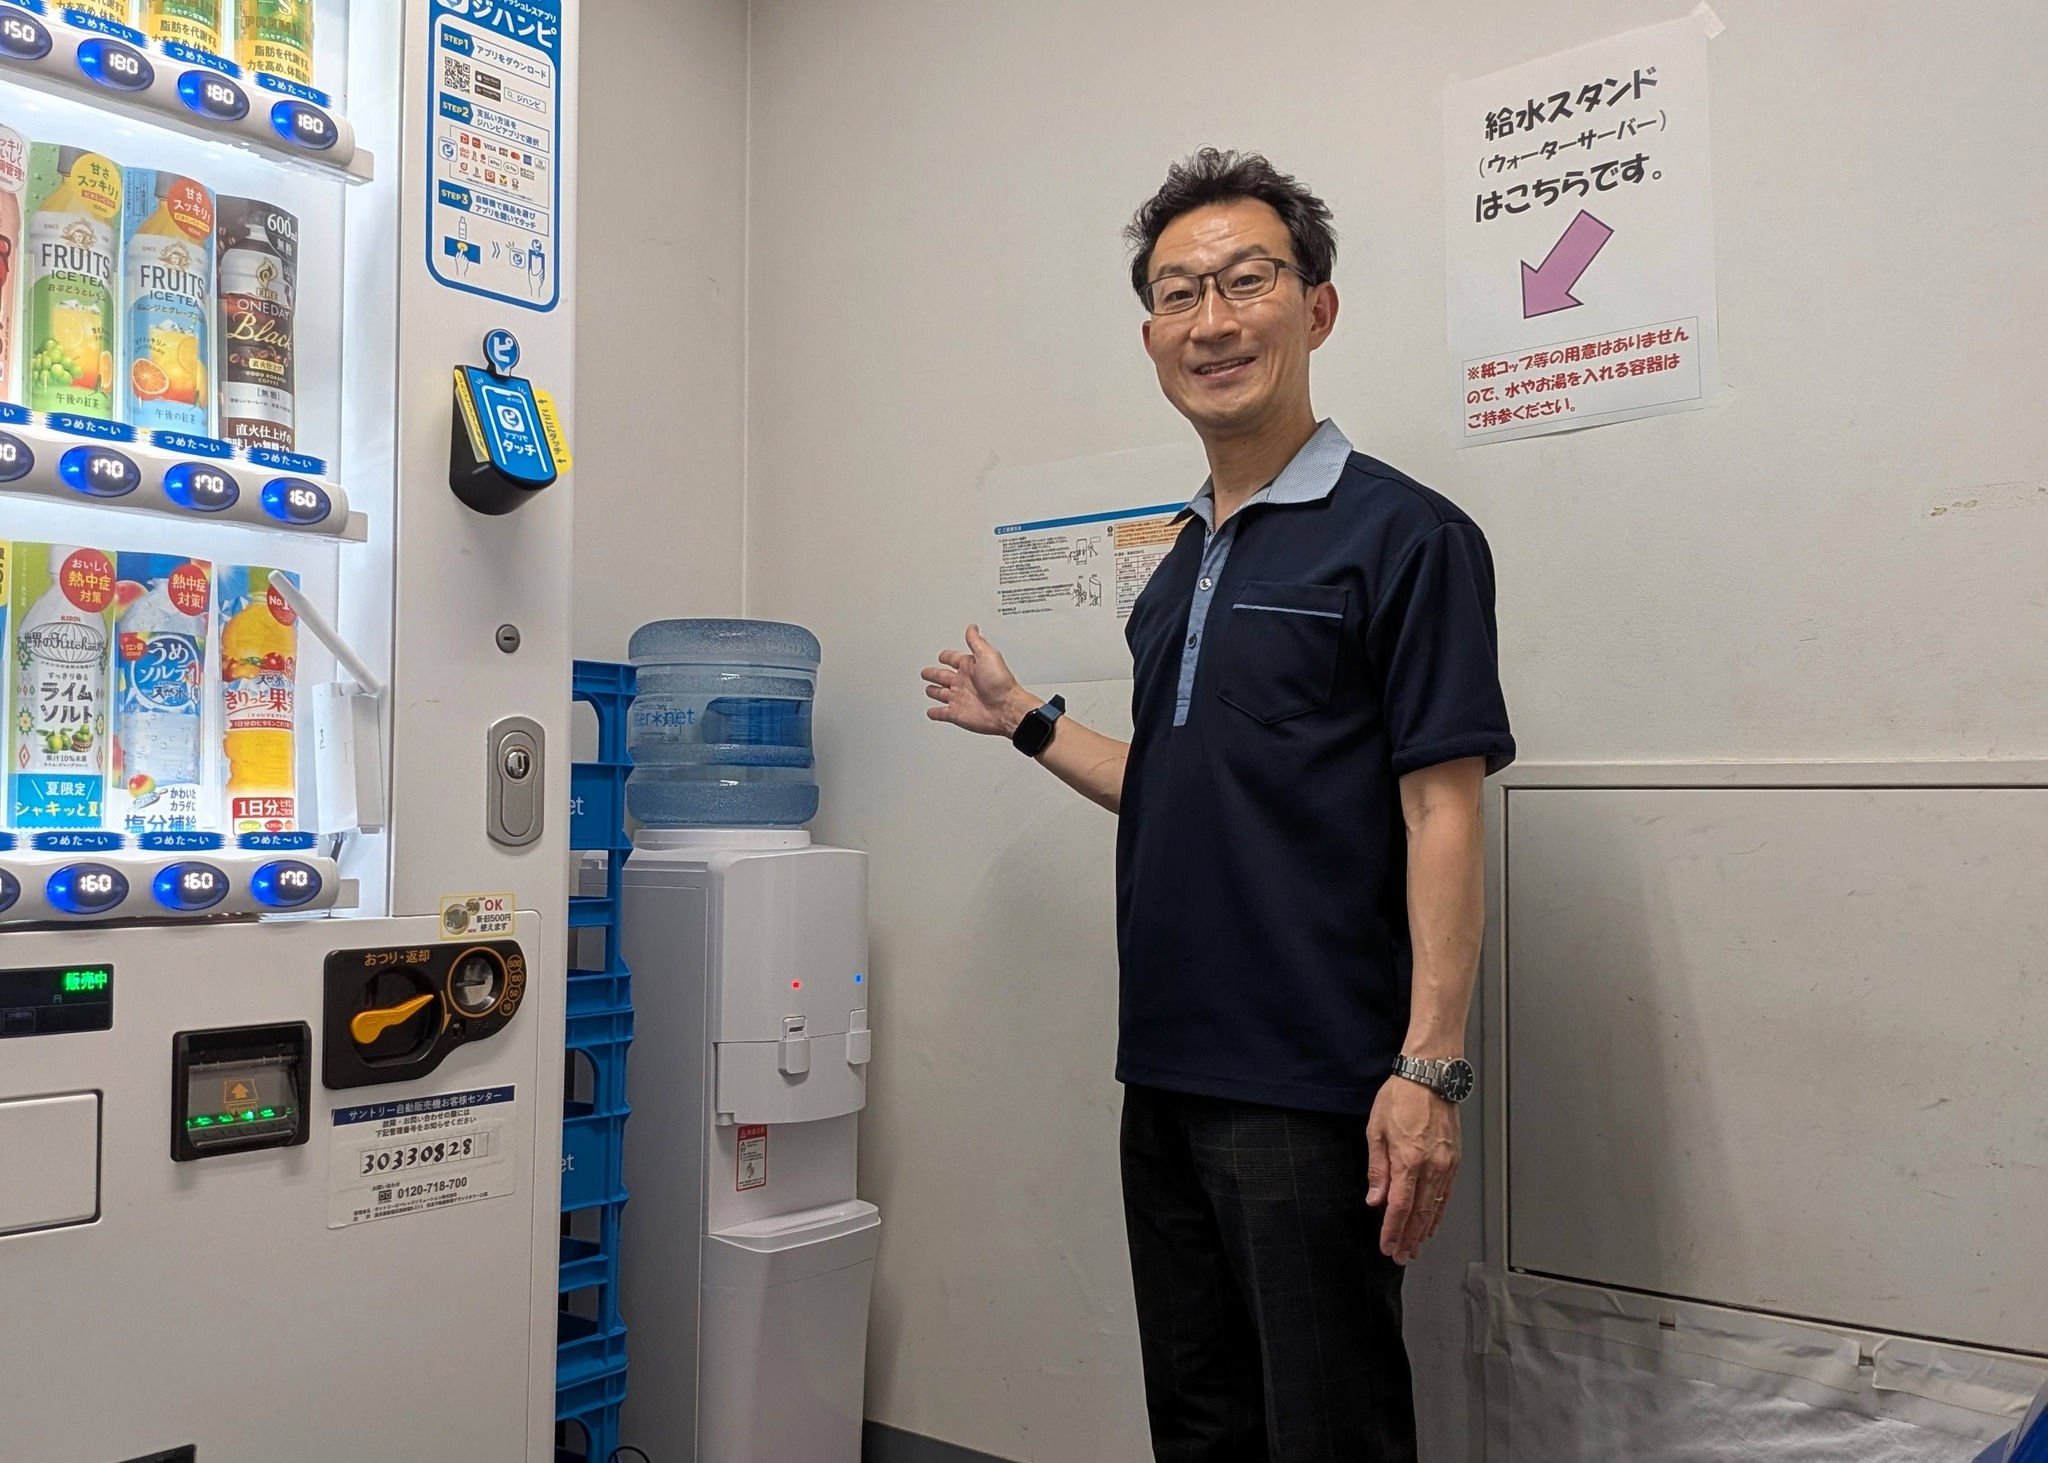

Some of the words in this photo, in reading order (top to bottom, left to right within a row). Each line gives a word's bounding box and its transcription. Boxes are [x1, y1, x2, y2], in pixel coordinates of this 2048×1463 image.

[4, 20, 35, 42] 150
[160, 20, 217, 48] 脂肪を代謝する
[472, 0, 557, 48] ジハンピ
[109, 53, 139, 75] 180
[254, 45, 309, 71] 脂肪を代謝する
[476, 45, 547, 79] アプリをダウンロード
[207, 84, 235, 105] 180
[516, 94, 541, 110] ジハンピ
[1484, 65, 1658, 141] 給水スタンド
[298, 113, 324, 134] 180
[476, 108, 517, 130] 支払い方法を
[476, 119, 540, 147] ジハンピアプリで選択
[483, 142, 497, 152] VISA
[1478, 109, 1667, 179] (ウォーターサーバー)
[90, 162, 110, 180] 甘さ
[77, 175, 119, 200] スッキリ!
[185, 186, 203, 204] 甘さ
[1474, 152, 1663, 223] はこちらです。
[173, 199, 211, 224] スッキリ!
[475, 195, 536, 220] 自販機で商品を選び
[475, 204, 537, 229] アプリを開いてタッチ
[41, 242, 111, 280] FRUITS
[51, 269, 78, 283] ICE
[80, 273, 105, 289] TEA
[140, 264, 205, 300] FRUITS
[150, 290, 174, 303] ICE
[176, 293, 200, 309] TEA
[256, 287, 278, 300] FIRE
[226, 311, 292, 351] Black
[493, 336, 513, 363] ピ
[1467, 326, 1690, 381] ※紙コップ等の用意はありません
[1466, 353, 1681, 405] ので、水やお湯を入れる容器は
[56, 392, 100, 409] 午後の紅茶
[155, 408, 196, 425] 午後の紅茶
[1467, 397, 1577, 429] ご持参ください。
[236, 424, 292, 444] 直火仕上げの
[503, 431, 529, 442] アプリで
[502, 440, 537, 457] タッチ
[92, 458, 124, 478] 170
[194, 474, 224, 493] 170
[289, 489, 317, 508] 160
[72, 558, 108, 574] おいしく
[68, 570, 111, 592] 熱中症
[172, 573, 207, 593] 熱中症
[80, 589, 102, 604] 対策
[177, 591, 204, 609] 対策!
[60, 614, 81, 622] KIRIN
[148, 642, 189, 666] うめ
[139, 664, 195, 684] ソルティ
[40, 682, 94, 702] ライム
[40, 704, 93, 724] ソルト
[46, 754, 87, 762] 果汁10%未満
[45, 781, 86, 796] 夏限定
[170, 787, 197, 800] かわいた
[170, 801, 197, 812] カラダに
[124, 814, 197, 833] 塩分補給
[80, 874, 112, 892] 160
[184, 872, 213, 889] 160
[280, 870, 307, 886] 170
[484, 899, 503, 911] OK
[476, 913, 512, 923] 新旧500円
[480, 922, 509, 932] 使えます
[364, 949, 430, 966] おつり・返却
[508, 958, 521, 969] 500
[65, 970, 108, 991] 販売中
[510, 973, 522, 983] 100
[509, 989, 519, 998] 50
[503, 1002, 512, 1011] 10
[348, 1093, 502, 1121] サントリー自動販売機お客様センター
[375, 1117, 477, 1138] 下記管理番号をお知らせください
[382, 1109, 470, 1128] 故障・お問い合わせの際には
[362, 1137, 473, 1174] 30330828
[397, 1176, 468, 1199] 0120-718-700
